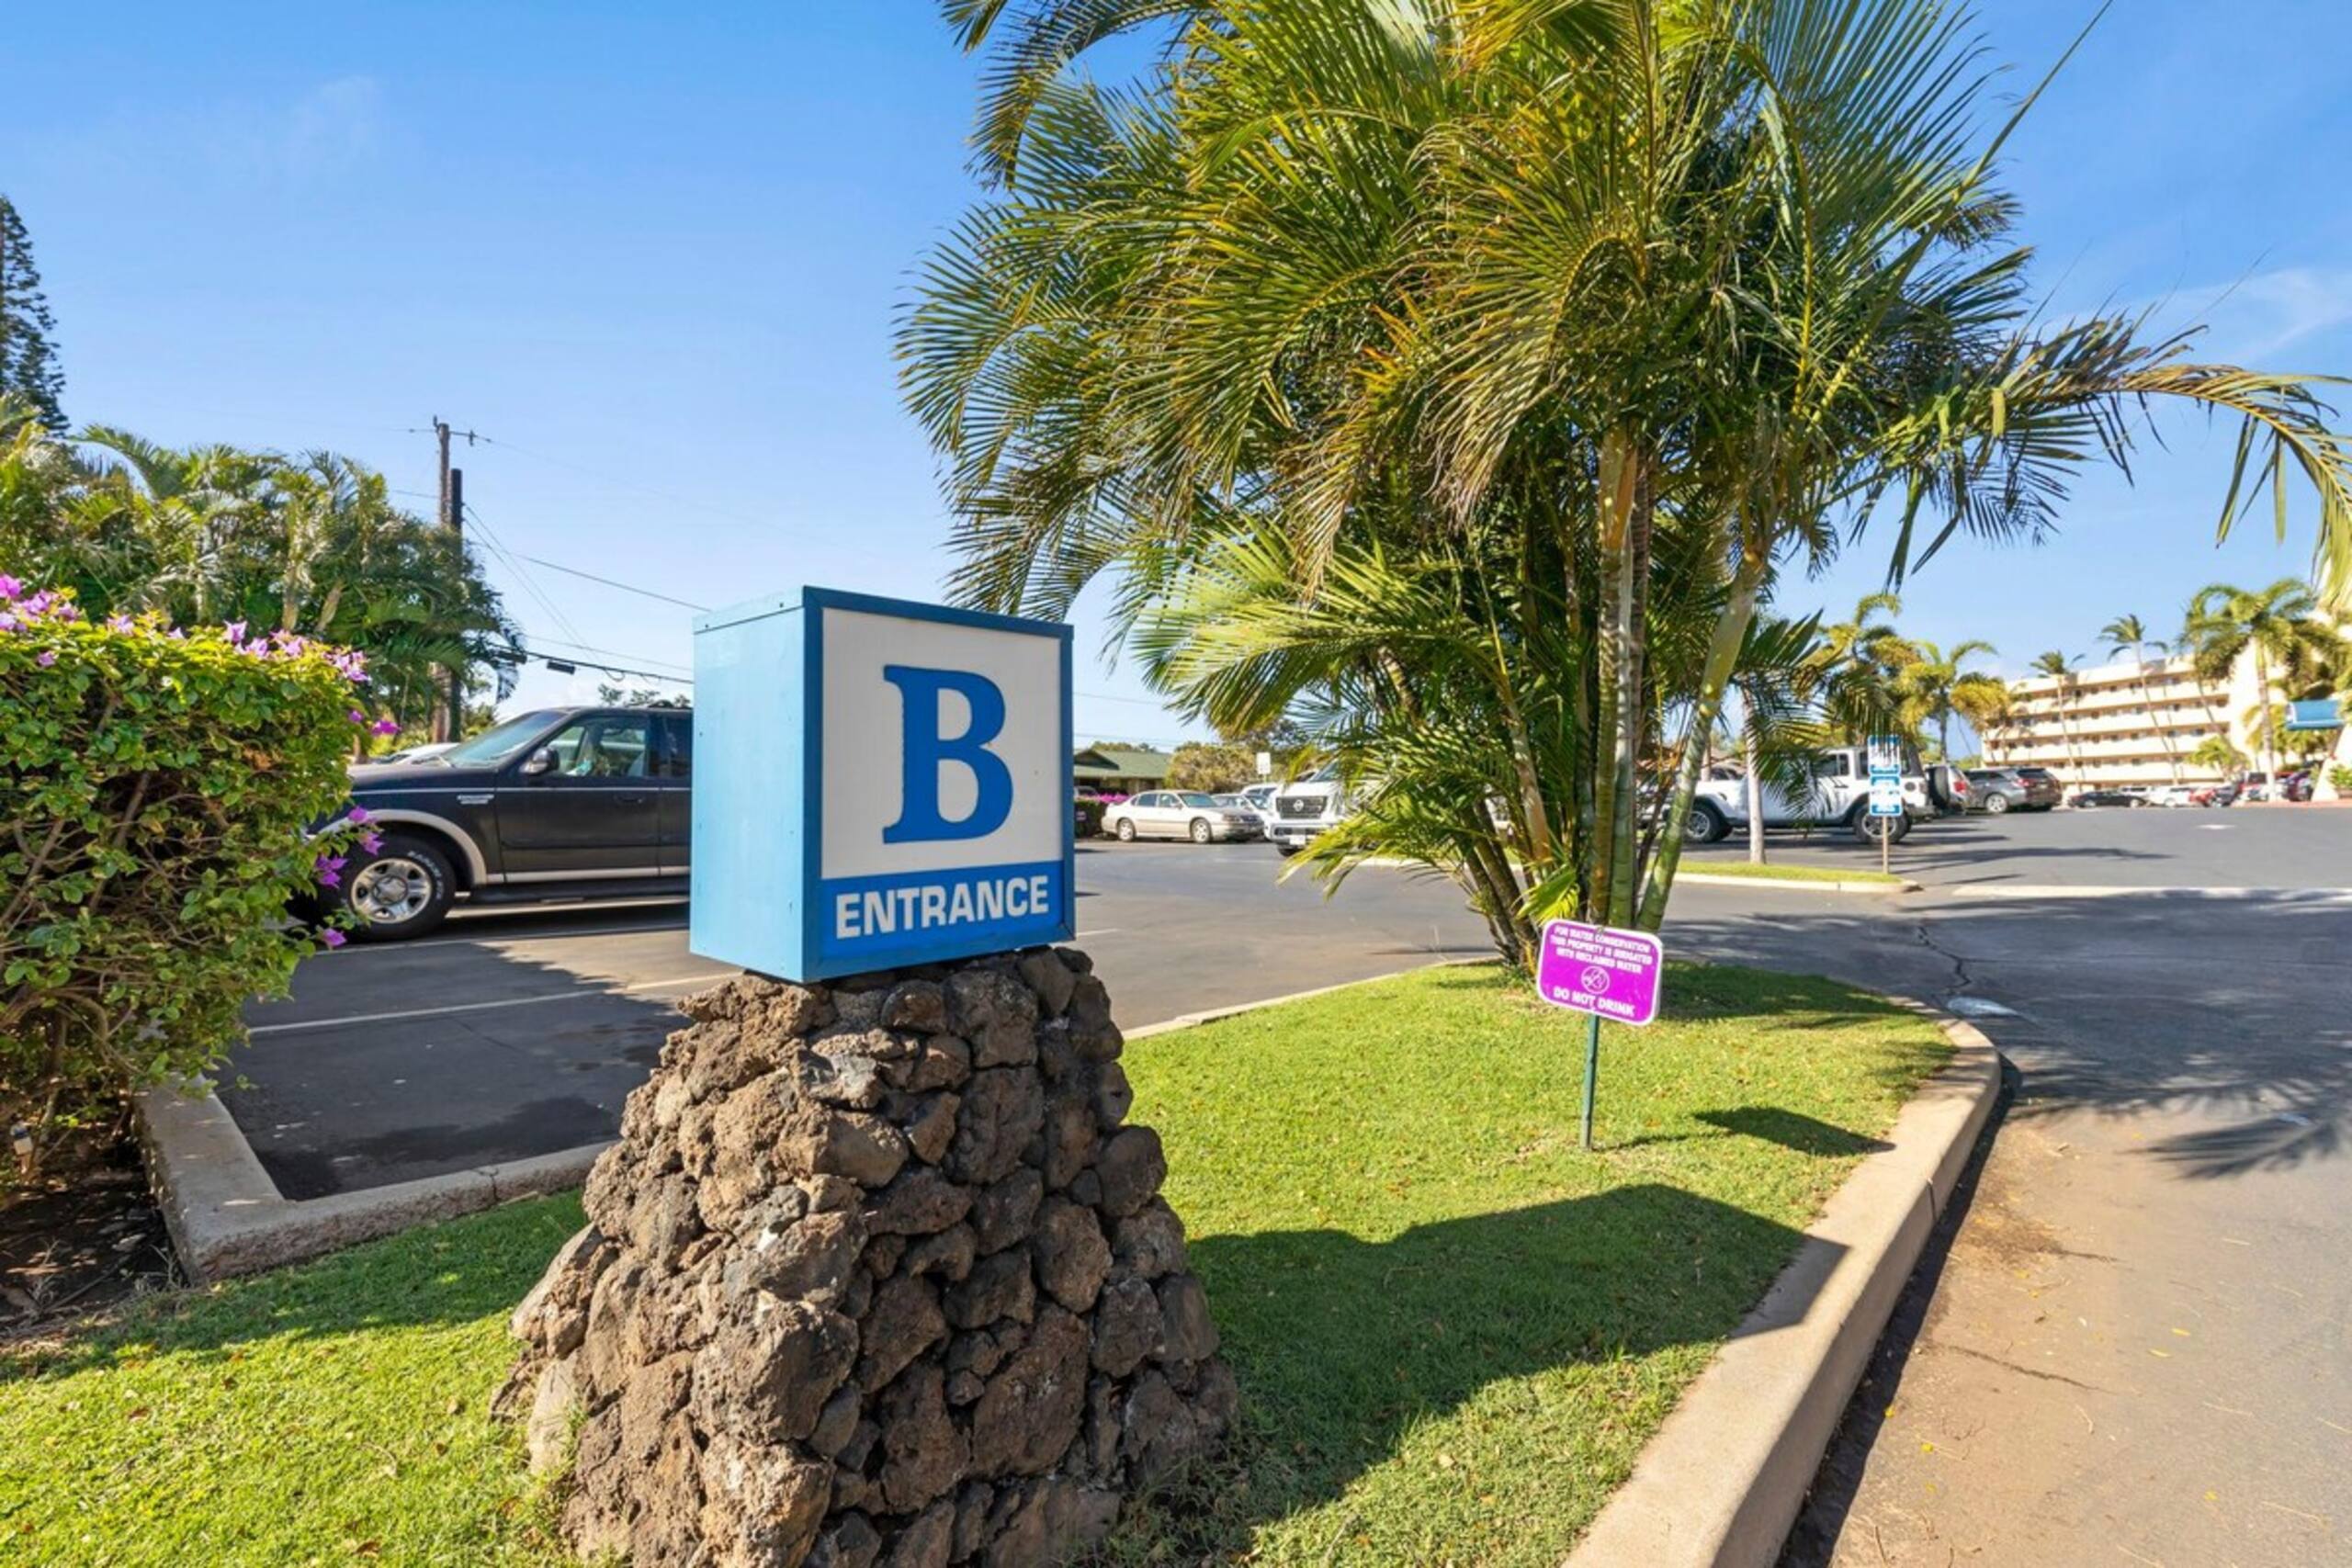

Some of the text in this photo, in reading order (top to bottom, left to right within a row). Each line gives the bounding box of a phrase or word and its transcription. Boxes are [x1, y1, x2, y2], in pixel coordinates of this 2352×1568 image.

[882, 664, 1013, 844] B
[835, 874, 1049, 940] ENTRANCE
[1554, 987, 1635, 1017] DO NOT DRINK
